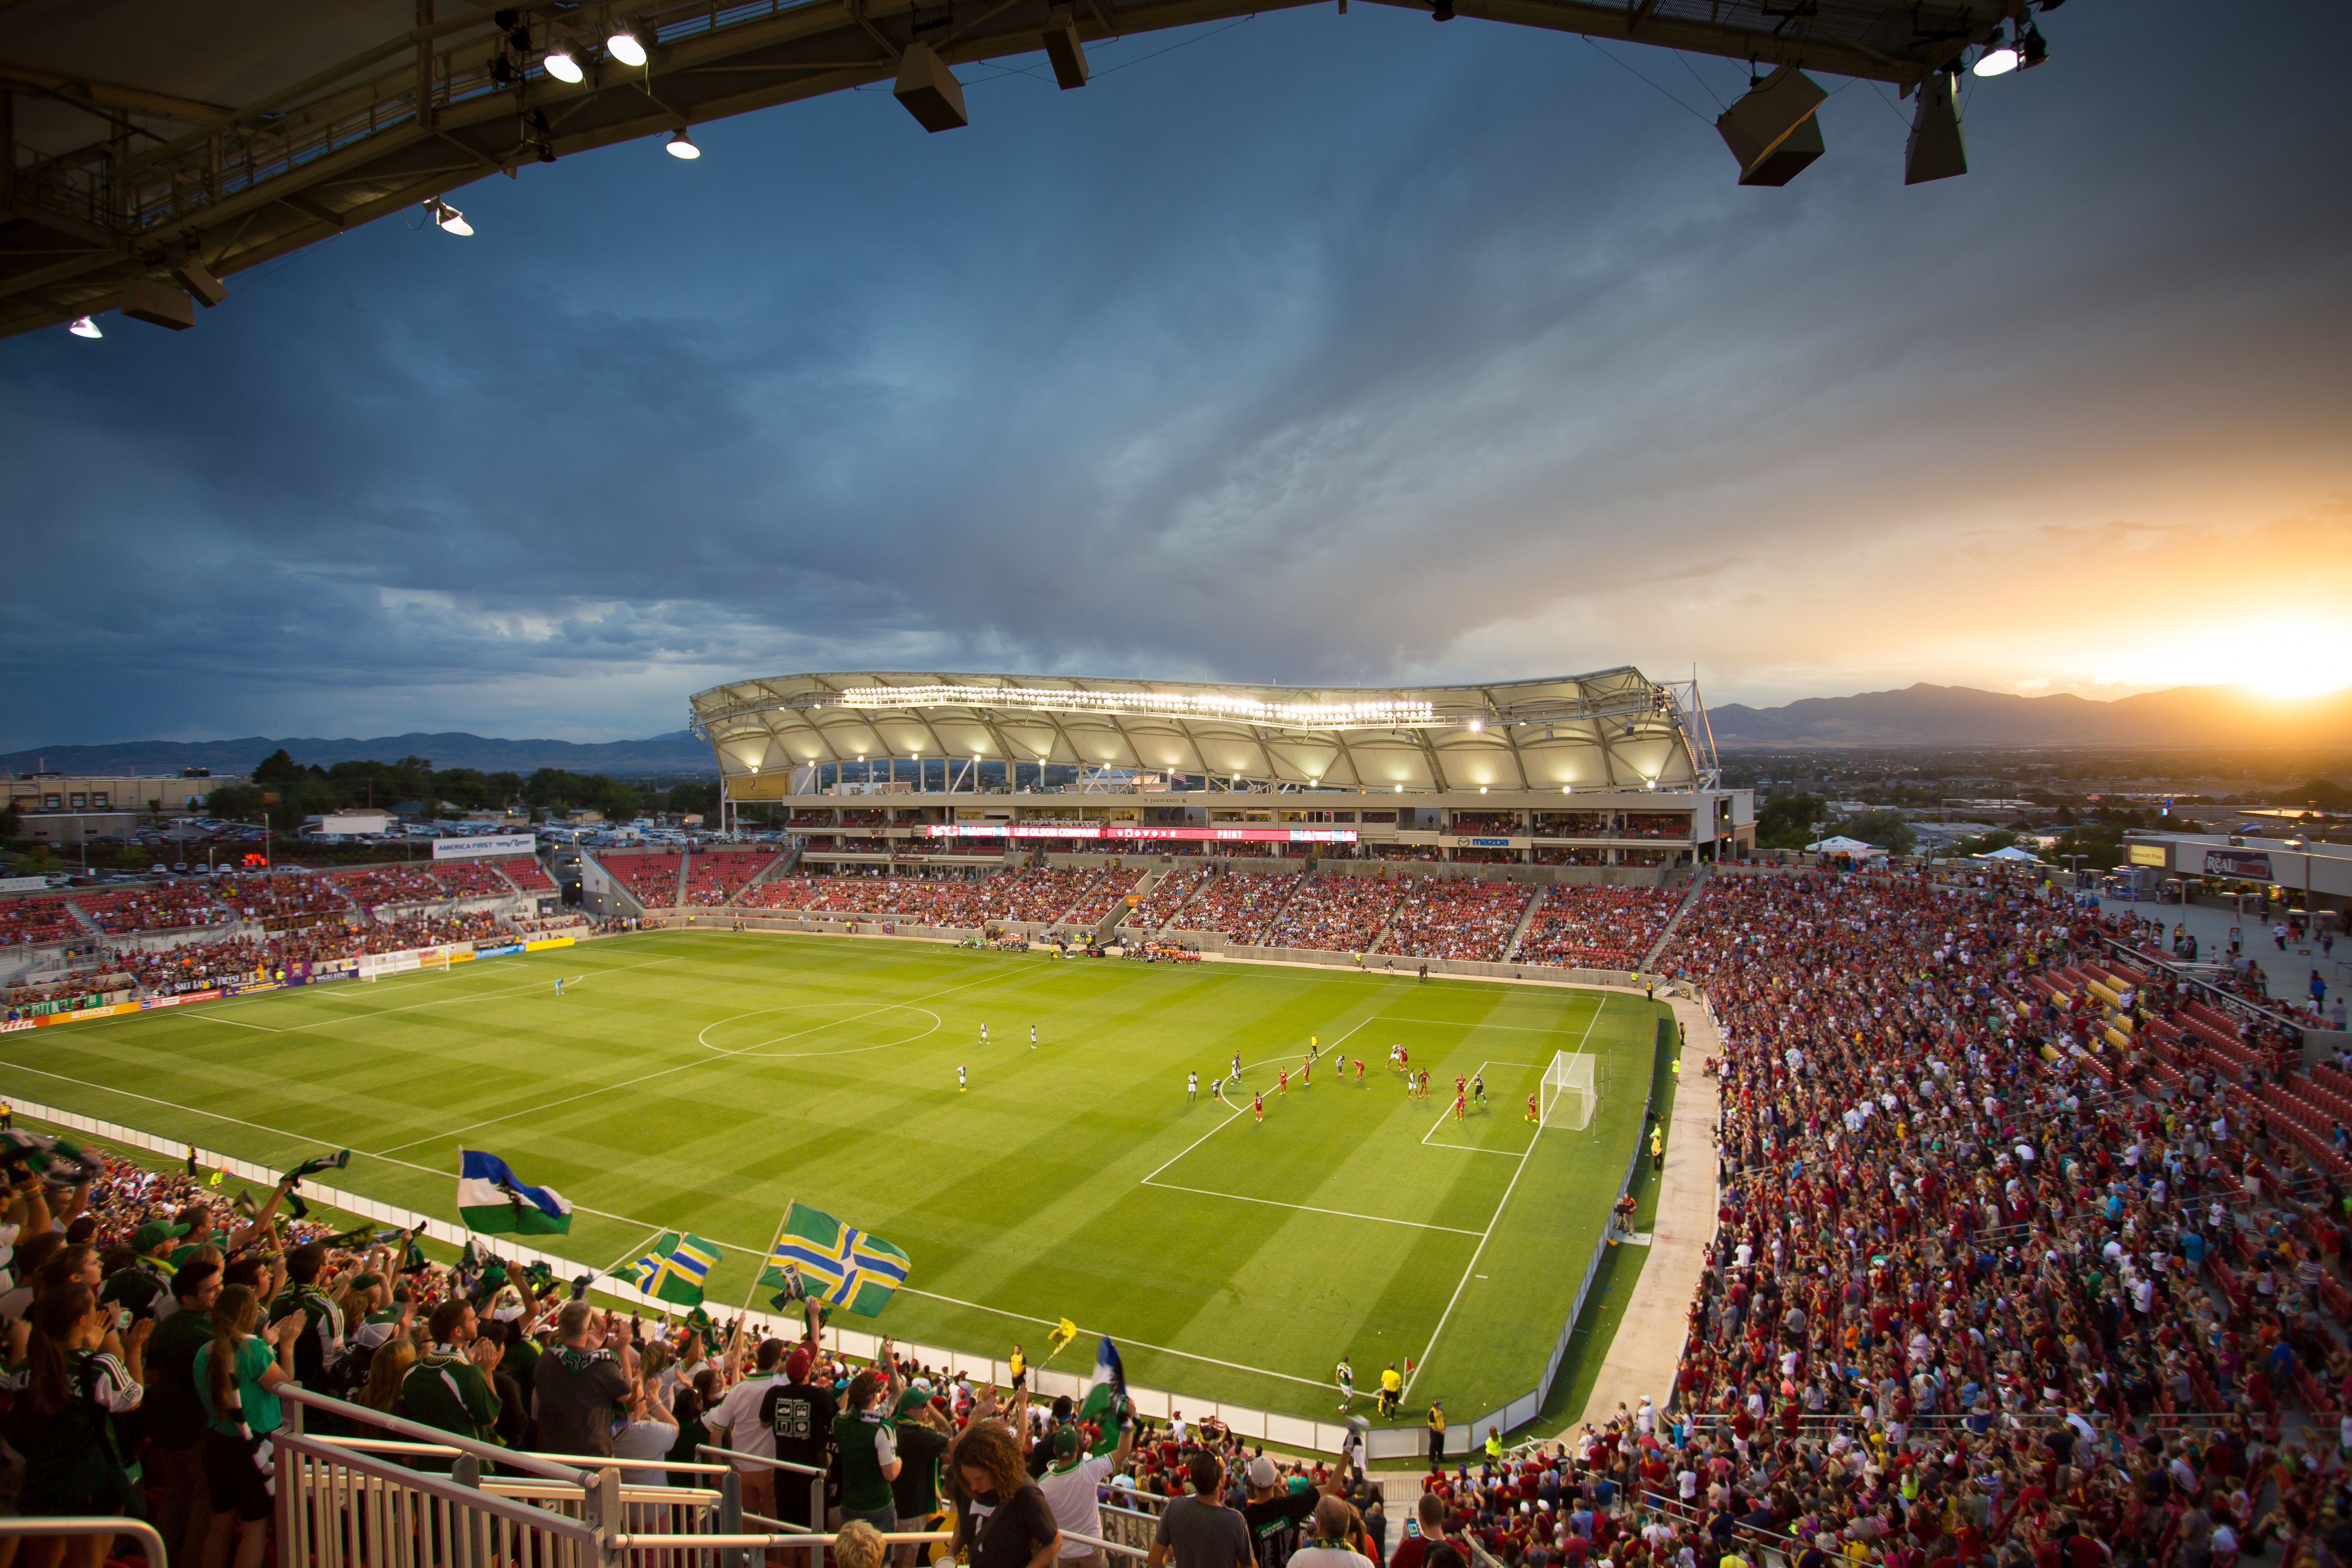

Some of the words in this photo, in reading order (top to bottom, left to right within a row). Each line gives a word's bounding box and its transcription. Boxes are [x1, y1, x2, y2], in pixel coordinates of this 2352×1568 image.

[1029, 828, 1057, 837] OLSON
[1058, 828, 1100, 837] COMPANY
[1217, 830, 1242, 839] PRINT
[1473, 838, 1509, 847] mazda
[81, 1005, 116, 1016] mozy
